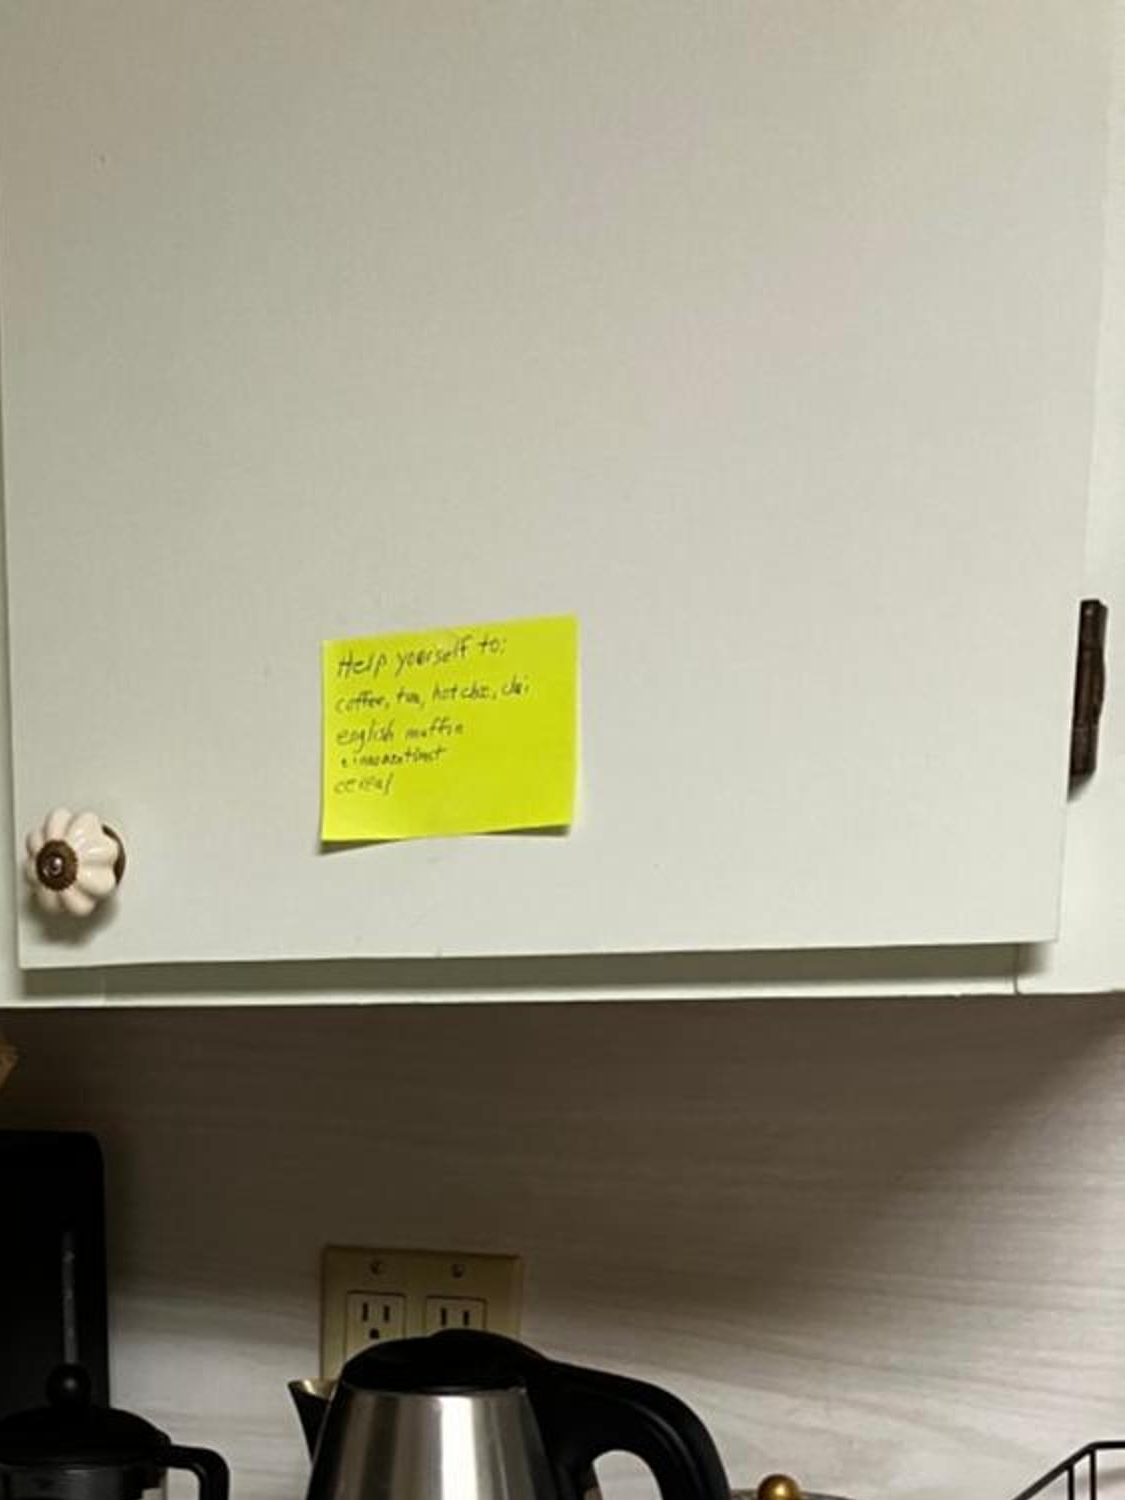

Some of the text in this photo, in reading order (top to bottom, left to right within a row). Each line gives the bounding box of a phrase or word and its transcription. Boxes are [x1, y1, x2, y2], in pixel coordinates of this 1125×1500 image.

[337, 633, 507, 680] Help yourself to:
[335, 718, 396, 754] english
